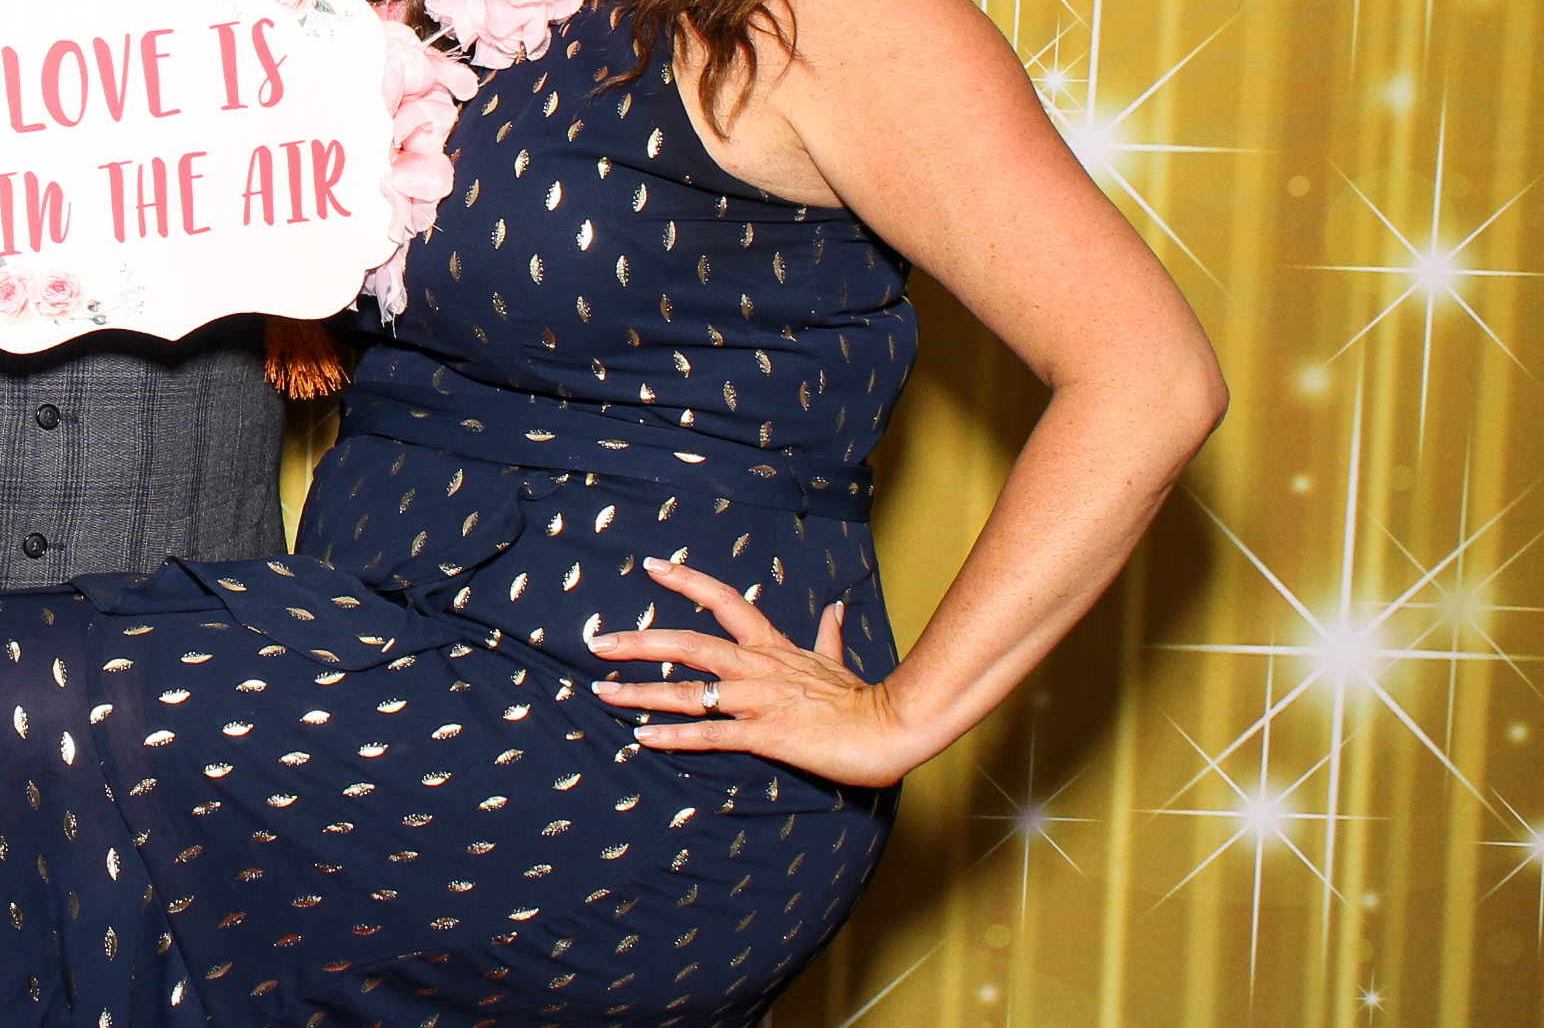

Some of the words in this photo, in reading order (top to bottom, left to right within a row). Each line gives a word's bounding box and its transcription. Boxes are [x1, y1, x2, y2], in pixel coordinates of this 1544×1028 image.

[1, 28, 182, 134] LOVE
[209, 18, 288, 111] IS
[97, 151, 212, 244] THE
[241, 138, 352, 227] AIR
